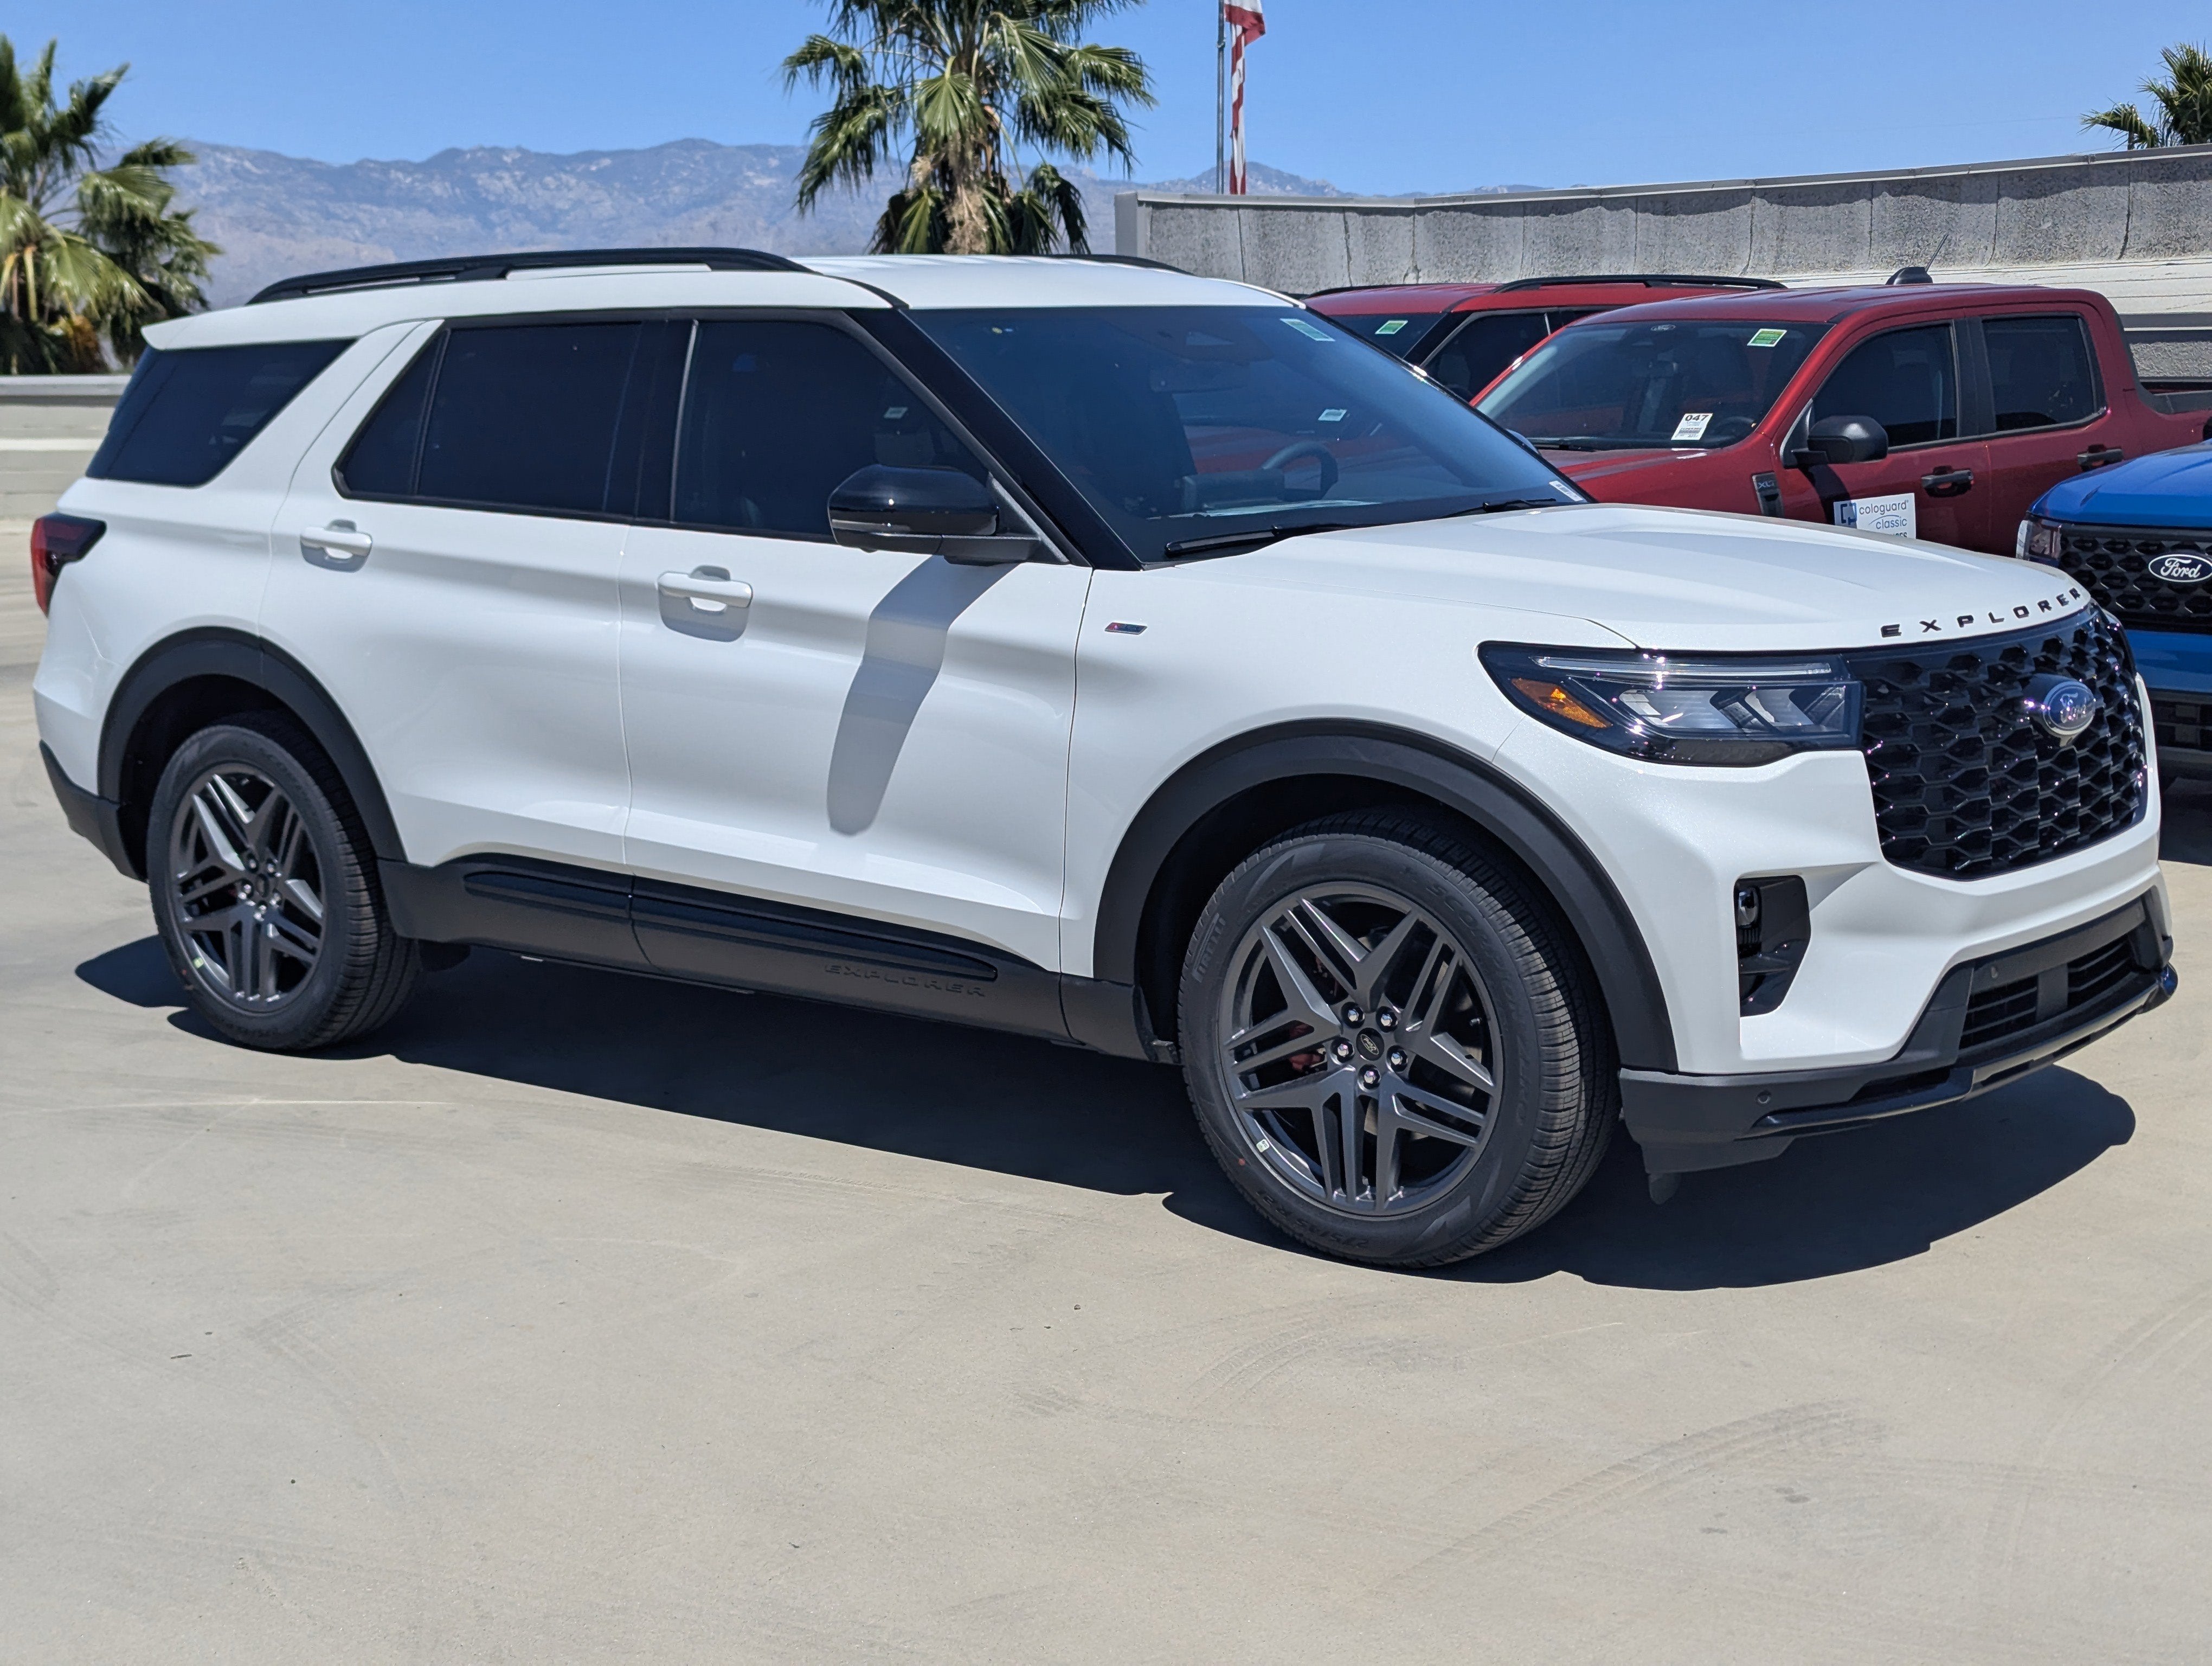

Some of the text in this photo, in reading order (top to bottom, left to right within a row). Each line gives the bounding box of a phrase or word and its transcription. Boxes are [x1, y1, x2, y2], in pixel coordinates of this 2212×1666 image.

[1876, 516, 1907, 530] classic
[2160, 558, 2202, 578] Ford
[1880, 587, 2081, 638] EXPLORER
[2060, 692, 2087, 724] Ford
[825, 964, 985, 997] EXPLORER
